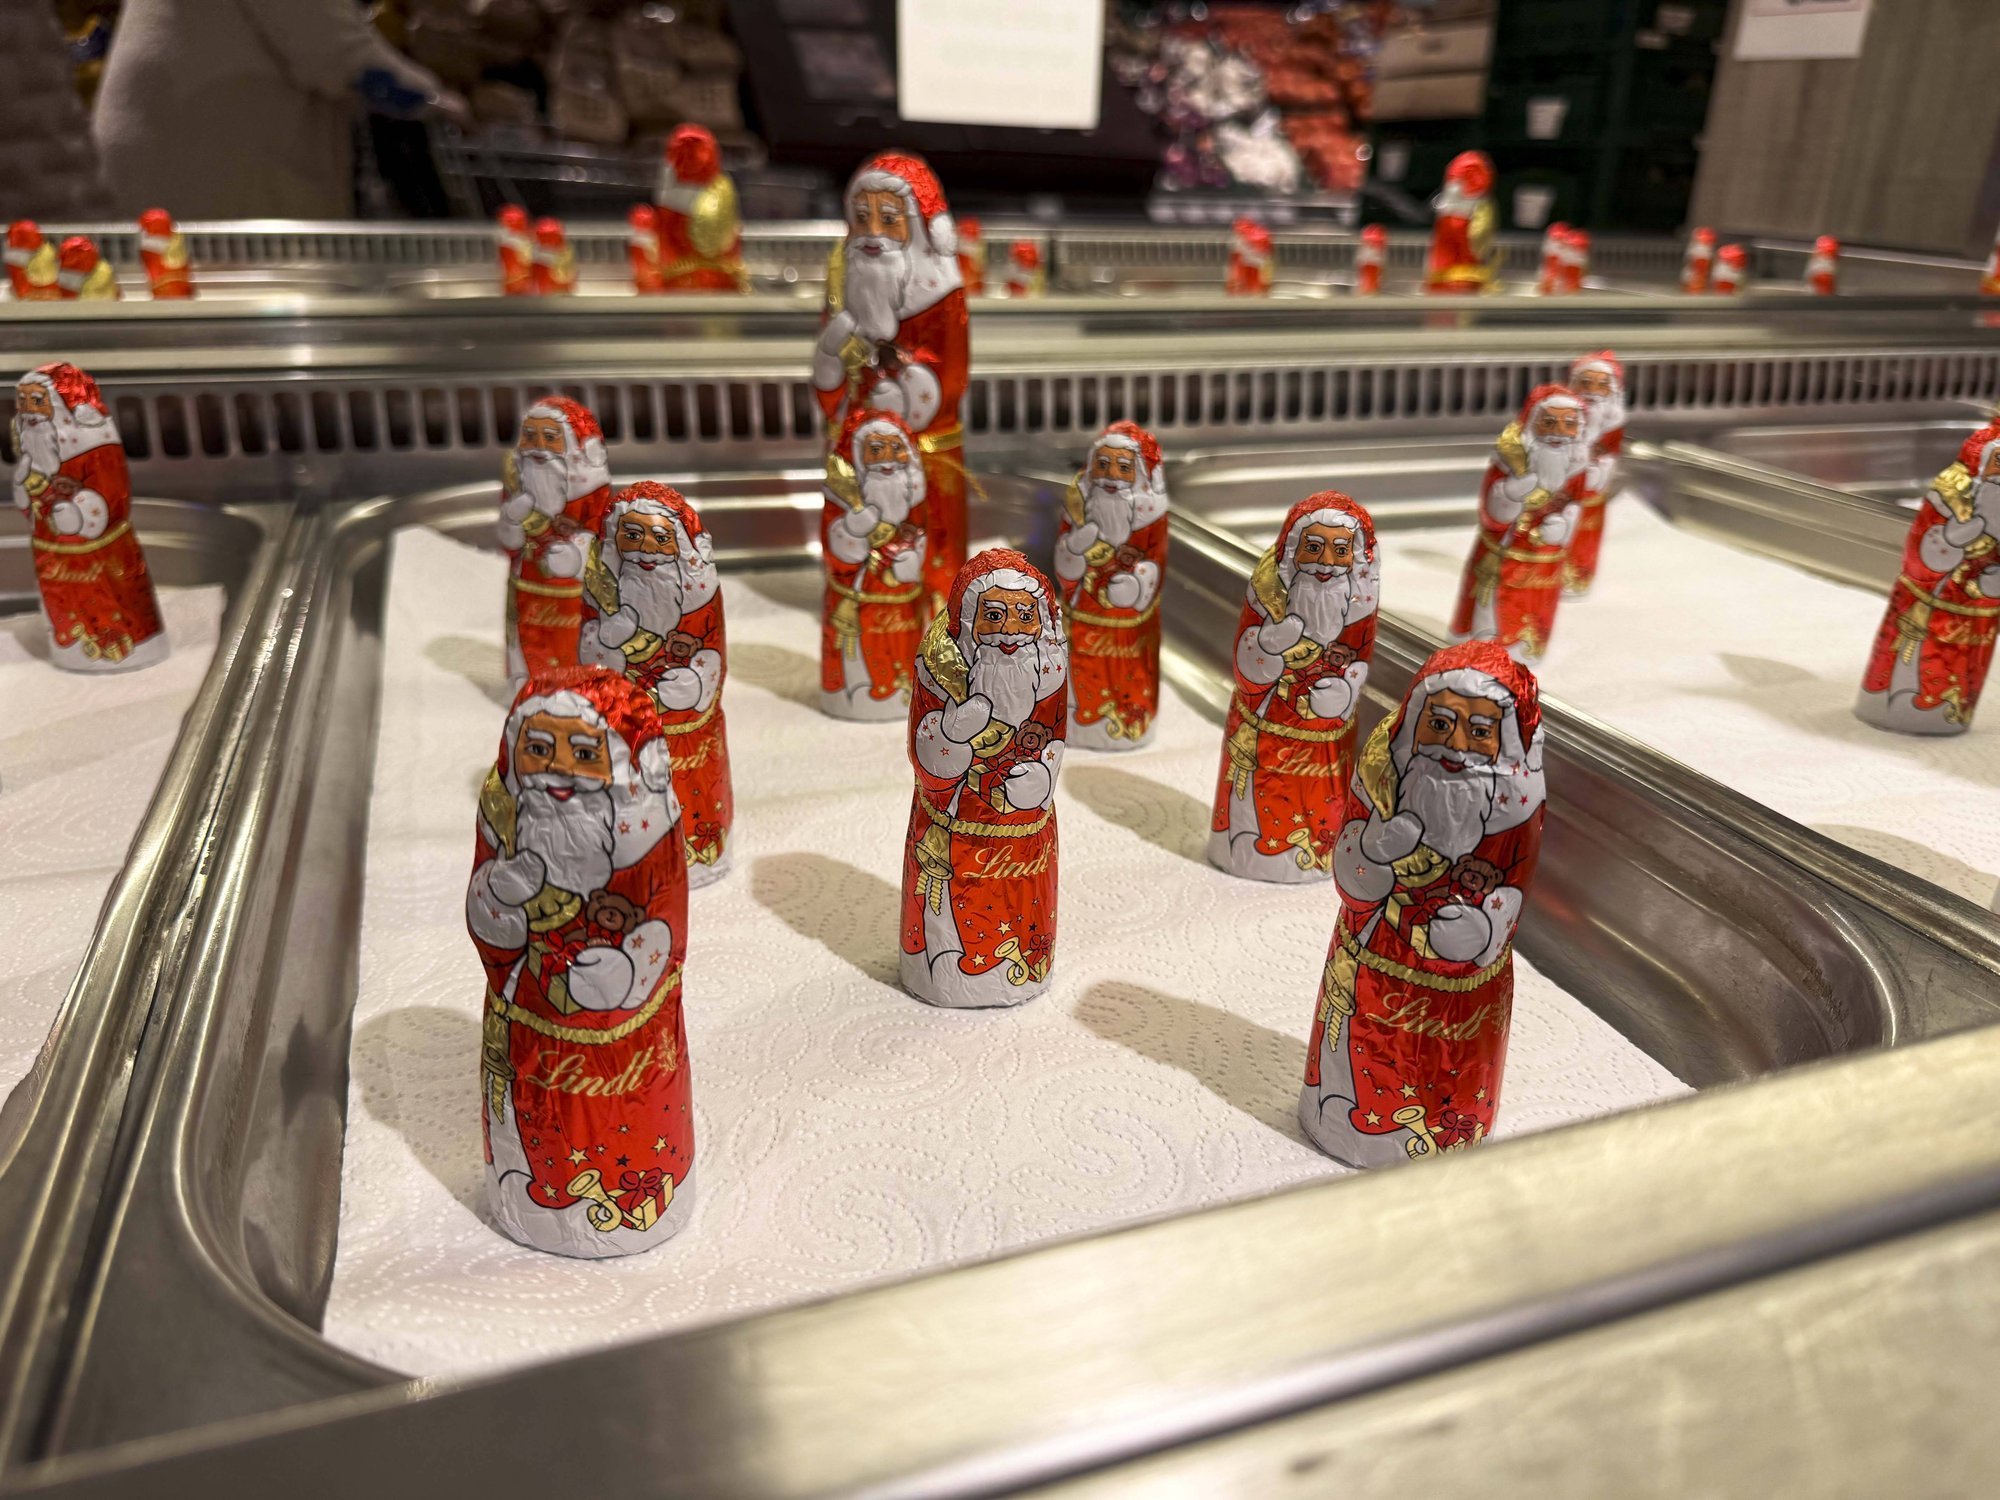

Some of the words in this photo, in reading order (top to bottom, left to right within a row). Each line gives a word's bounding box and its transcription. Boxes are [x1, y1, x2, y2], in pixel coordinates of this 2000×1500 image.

[668, 738, 716, 771] ndt
[962, 839, 1052, 879] Lindt
[1365, 992, 1490, 1041] Lindt
[525, 1047, 654, 1097] Lindt
